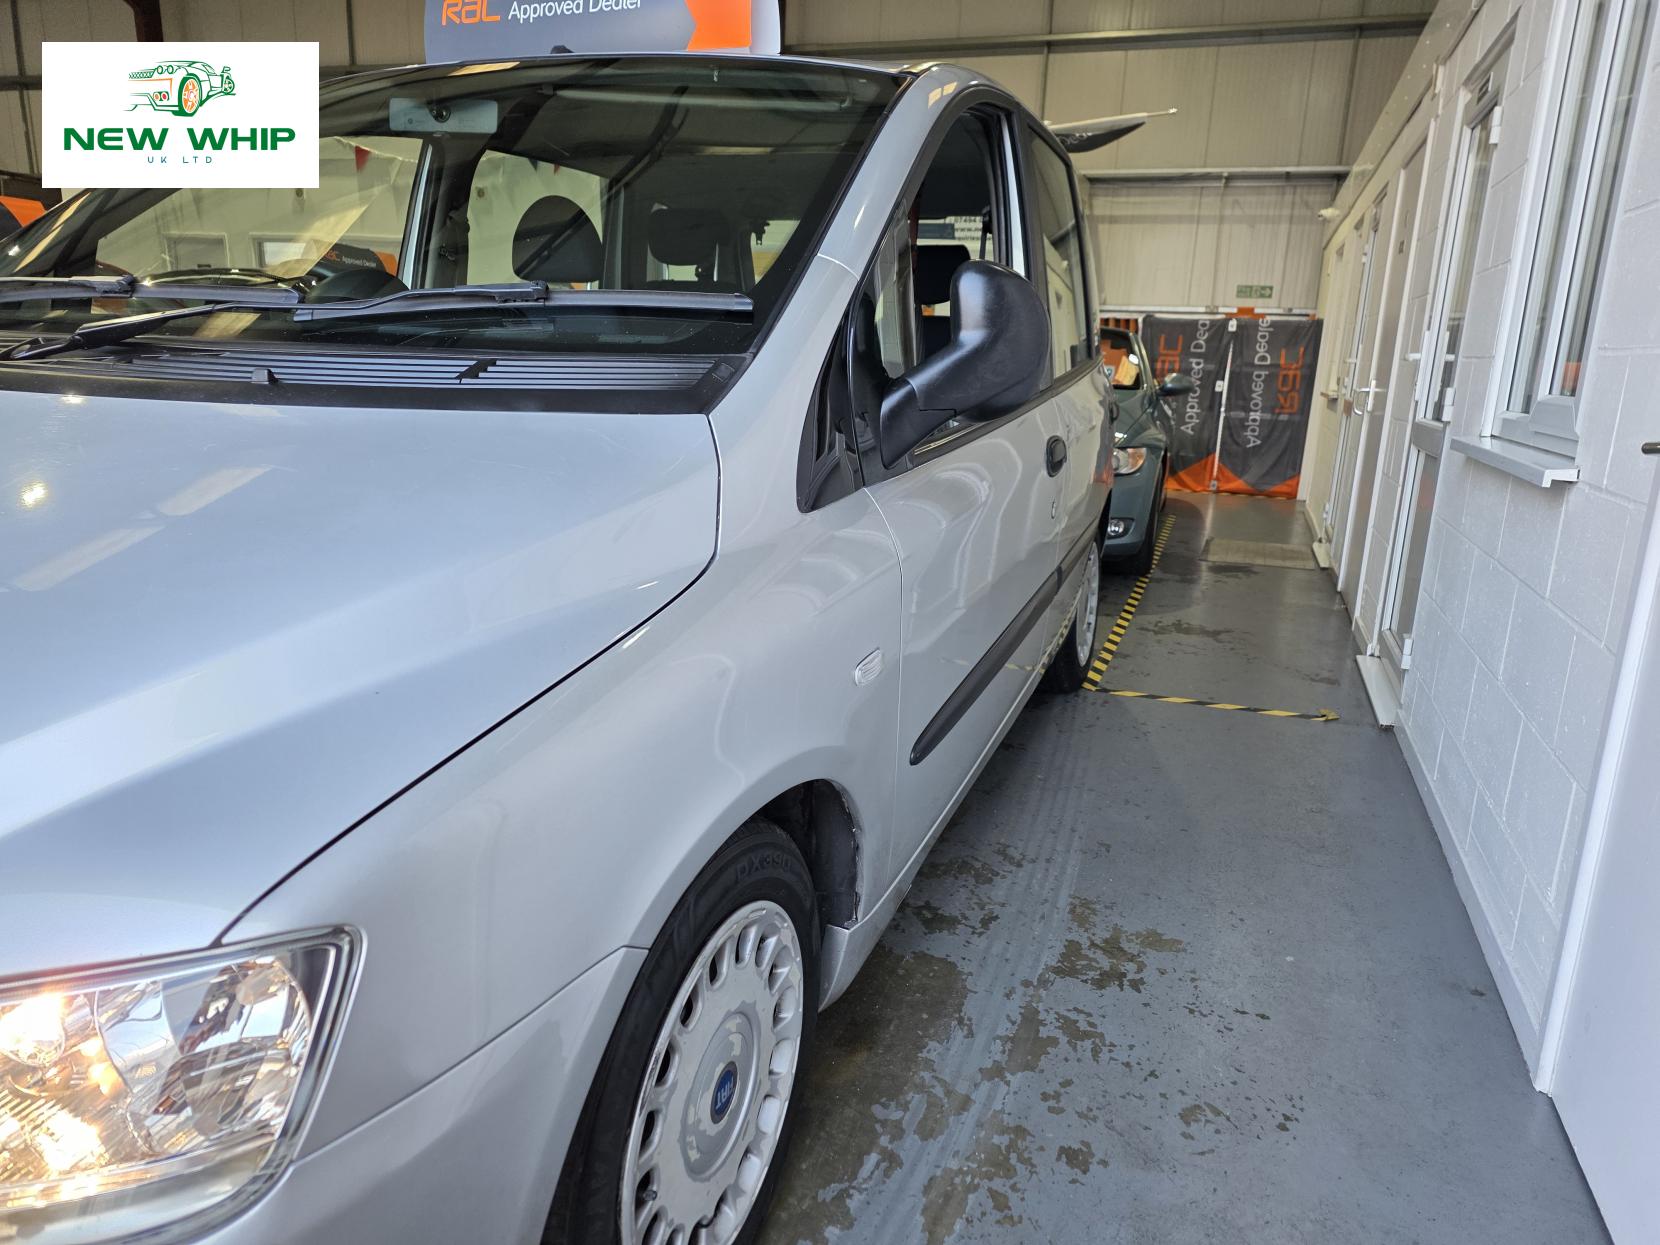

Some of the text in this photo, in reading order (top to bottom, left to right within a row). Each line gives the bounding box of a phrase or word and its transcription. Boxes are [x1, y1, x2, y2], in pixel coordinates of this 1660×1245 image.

[508, 0, 584, 24] Approved
[1180, 358, 1205, 435] Approved
[715, 1077, 734, 1110] FIAT
